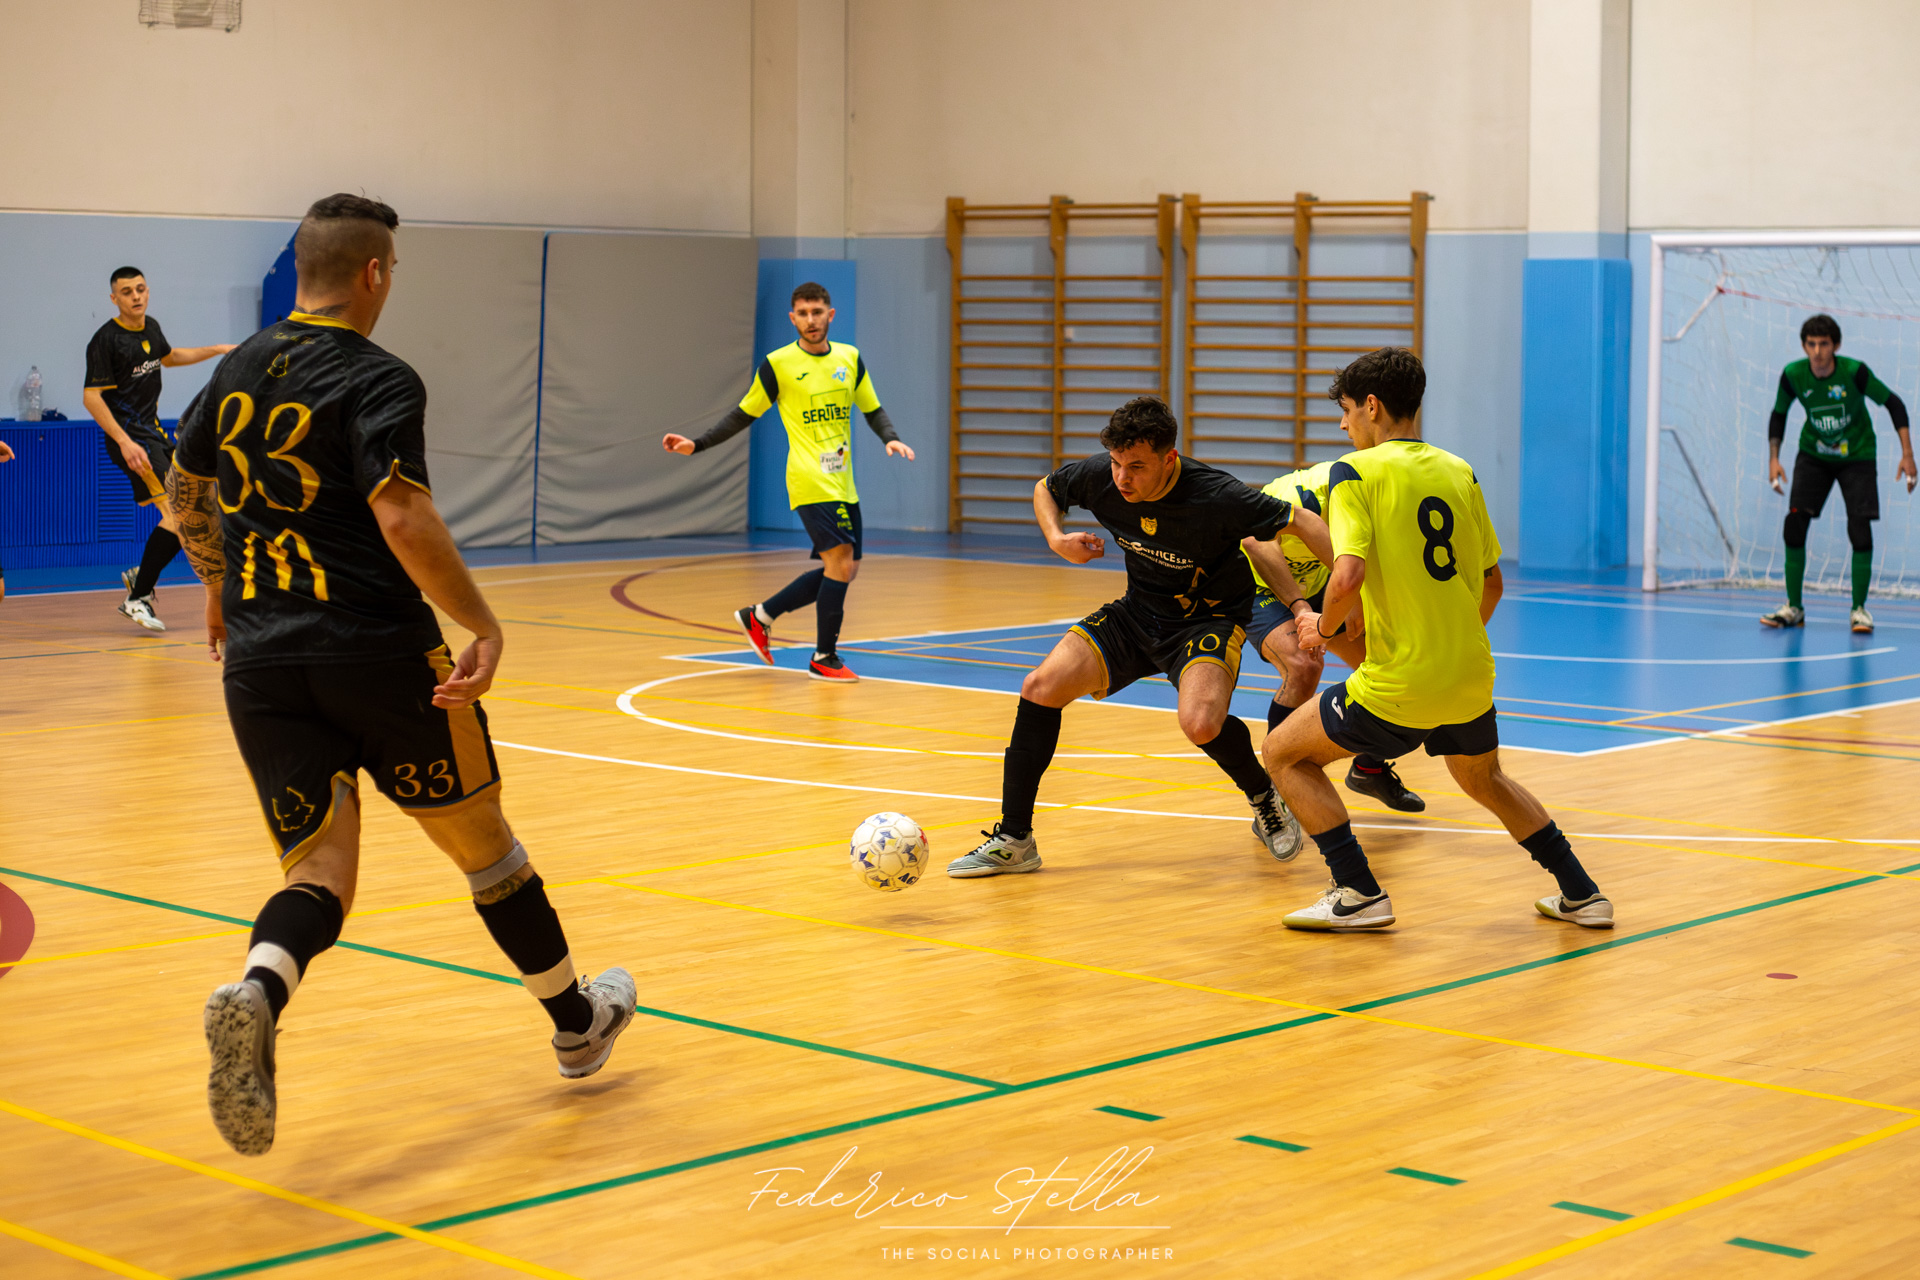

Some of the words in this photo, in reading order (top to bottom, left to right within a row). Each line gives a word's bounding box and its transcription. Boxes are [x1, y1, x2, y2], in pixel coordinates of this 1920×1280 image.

[217, 391, 321, 515] 33
[1417, 495, 1457, 582] 8
[1185, 633, 1221, 657] 10
[394, 759, 455, 799] 33
